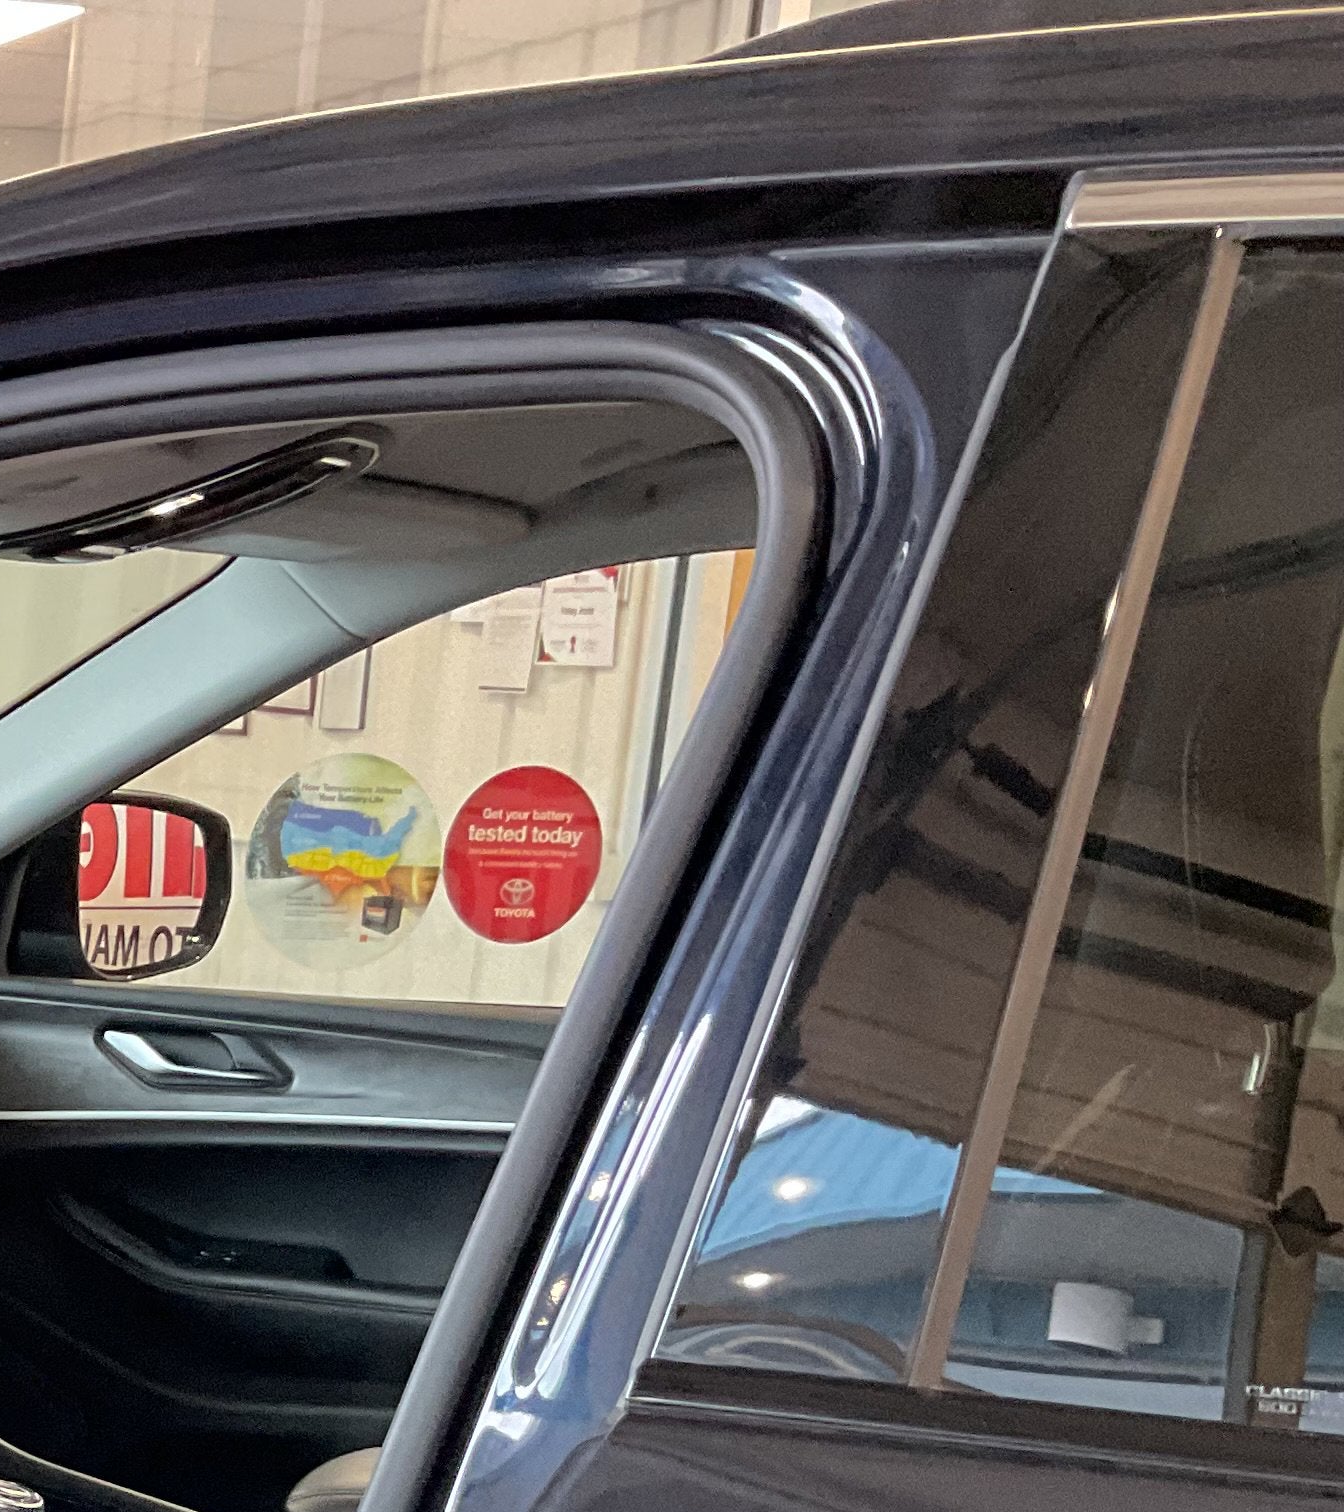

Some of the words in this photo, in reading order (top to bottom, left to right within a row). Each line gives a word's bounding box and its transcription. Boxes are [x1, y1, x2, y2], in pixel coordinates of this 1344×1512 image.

[482, 808, 503, 820] Get
[505, 811, 531, 823] your
[532, 810, 574, 824] battery
[468, 824, 527, 843] tested
[531, 826, 583, 848] today
[494, 907, 536, 918] TOYOTA
